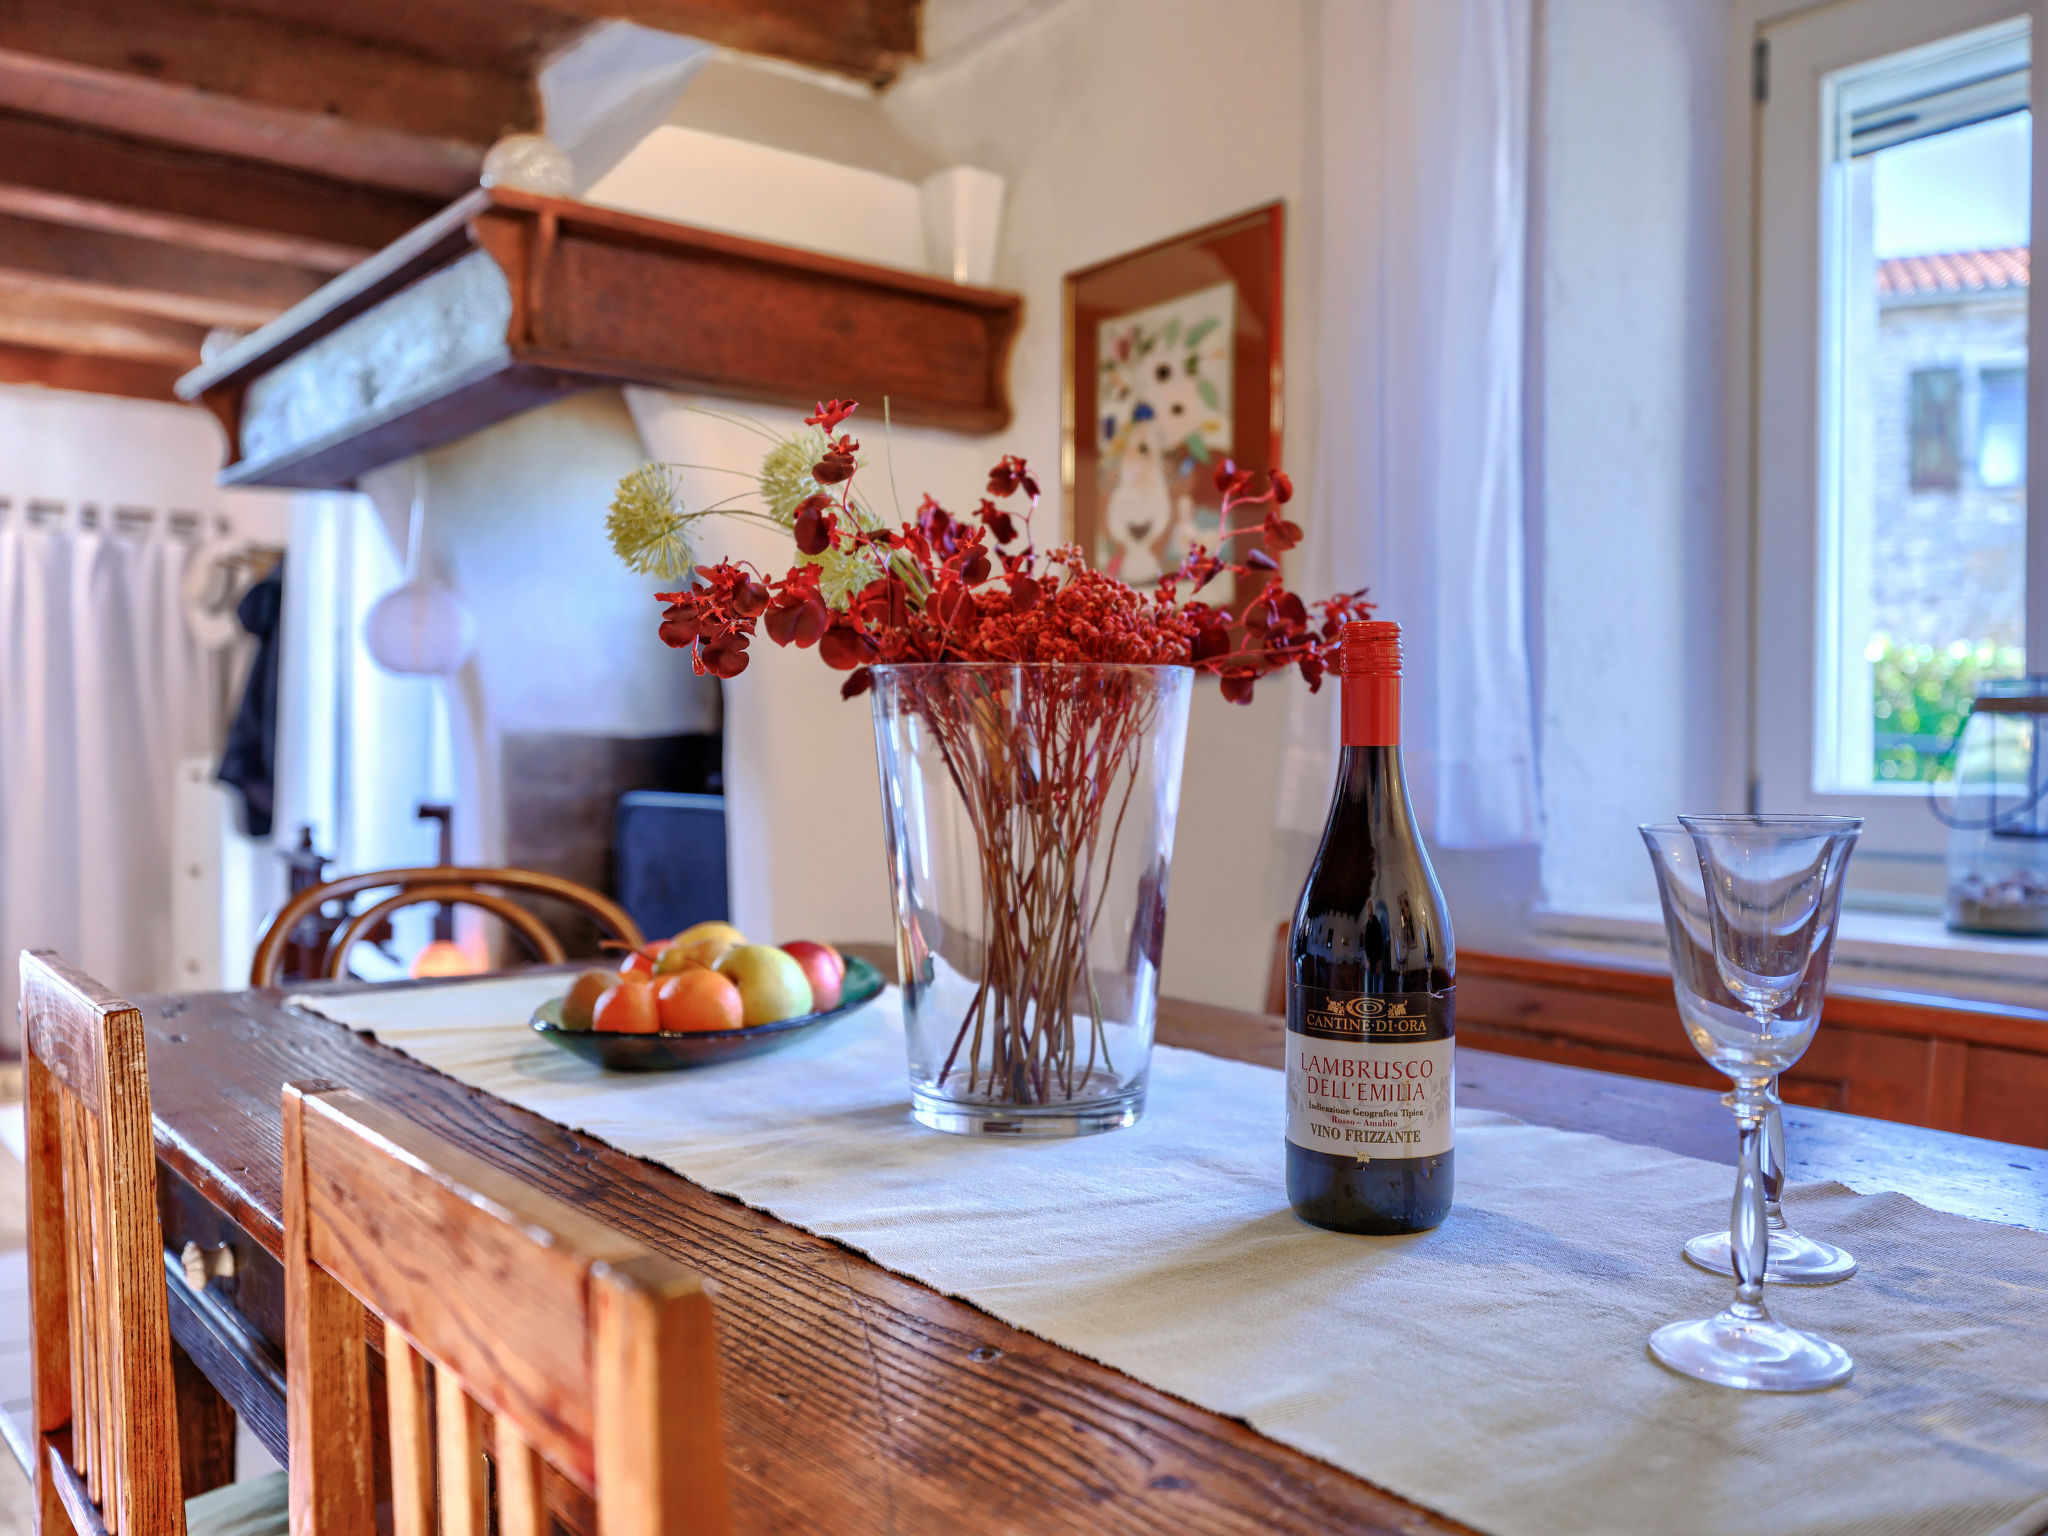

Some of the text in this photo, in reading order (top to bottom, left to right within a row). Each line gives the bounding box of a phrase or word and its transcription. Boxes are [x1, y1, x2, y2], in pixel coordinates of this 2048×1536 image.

[1306, 1014, 1370, 1032] CANTINE
[1301, 1053, 1433, 1080] LAMBRUSCO
[1307, 1076, 1425, 1102] DELL'EMILIA
[1308, 1101, 1424, 1119] Indicazione Geografica Tipica
[1331, 1115, 1355, 1126] Rosso
[1363, 1119, 1398, 1128] Amabile
[1310, 1123, 1421, 1143] VINO FRIZZANTE
